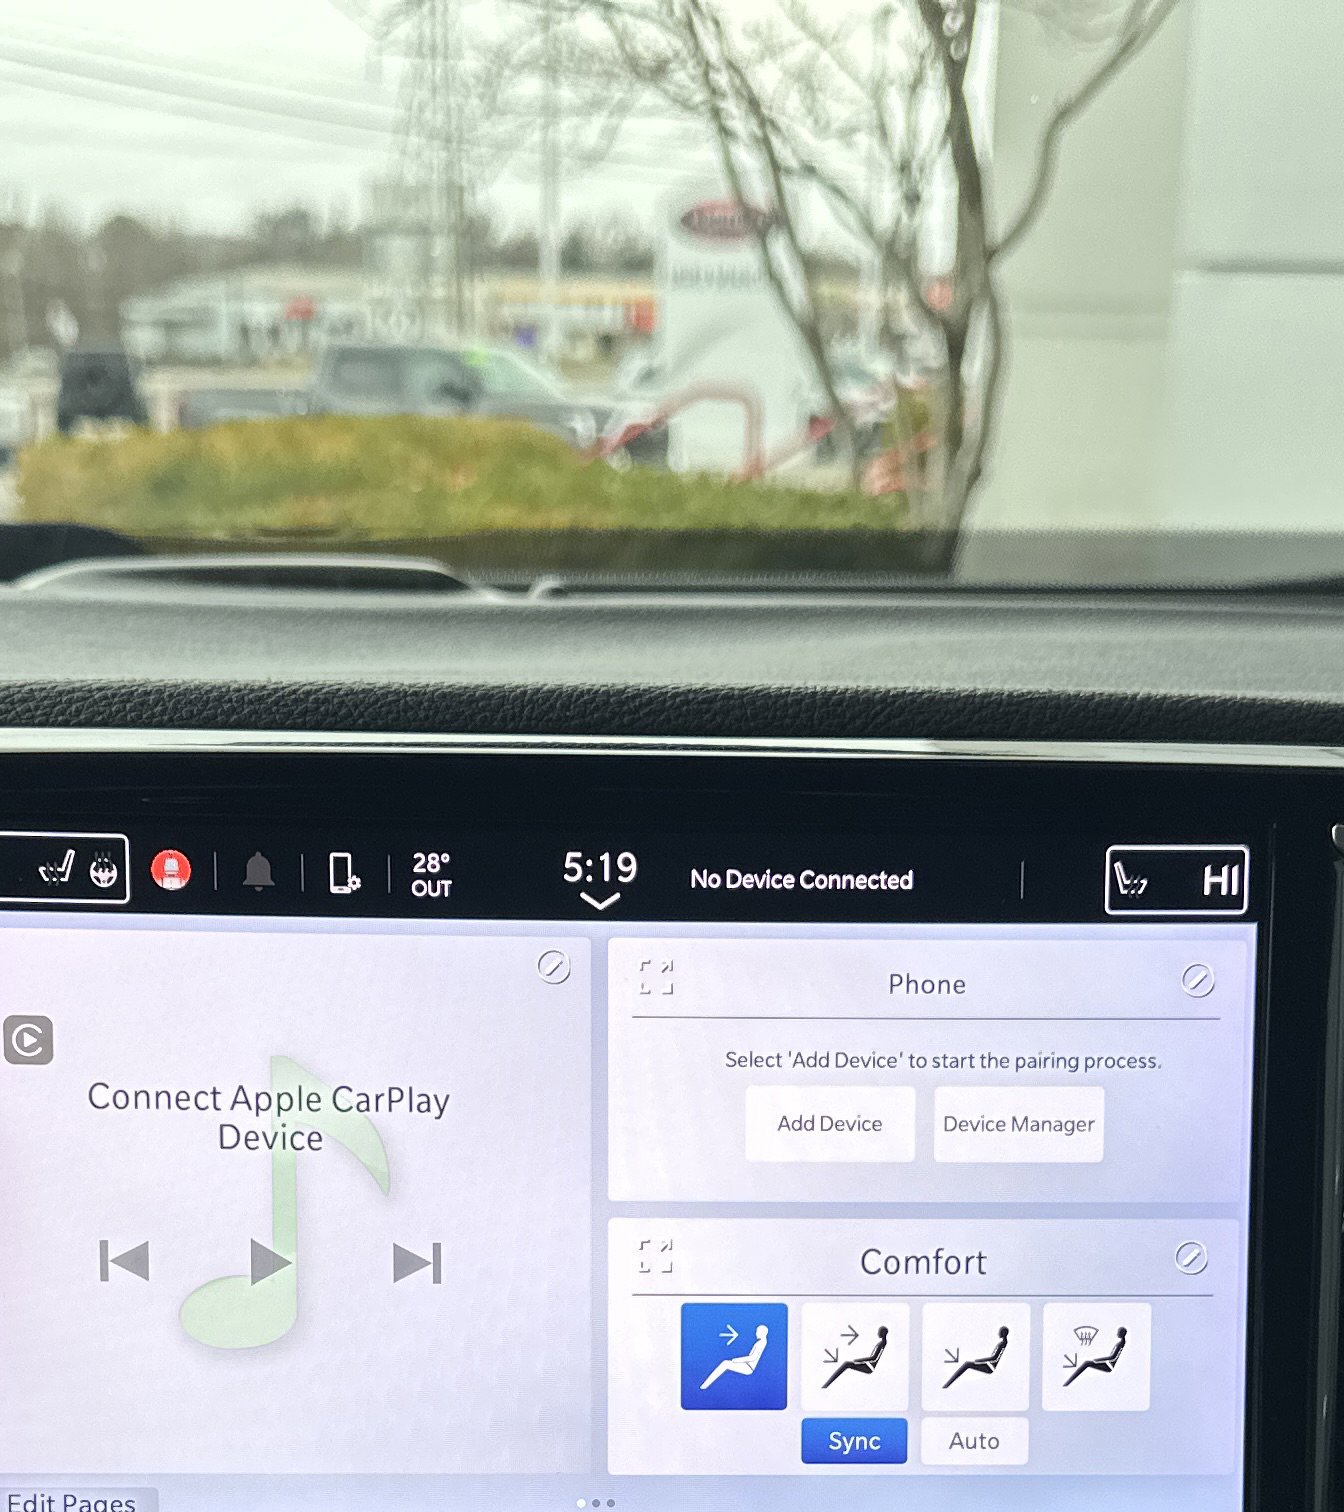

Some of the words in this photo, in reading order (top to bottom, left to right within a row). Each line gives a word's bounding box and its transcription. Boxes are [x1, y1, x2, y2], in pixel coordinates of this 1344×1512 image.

[563, 851, 637, 883] 5:19
[411, 879, 453, 898] OUT
[690, 868, 722, 889] No
[725, 868, 796, 890] Device
[799, 869, 914, 890] Connected
[1203, 864, 1240, 896] HI
[889, 972, 966, 995] Phone
[725, 1050, 783, 1068] Select
[788, 1050, 830, 1069] 'Add
[835, 1051, 903, 1069] Device'
[909, 1054, 928, 1069] to
[932, 1053, 976, 1069] start
[980, 1051, 1010, 1069] the
[1015, 1051, 1079, 1073] pairing
[1084, 1056, 1162, 1073] process.
[88, 1082, 222, 1112] Connect
[230, 1084, 322, 1118] Apple
[332, 1085, 450, 1120] CarPlay
[777, 1114, 815, 1132] Add
[820, 1114, 883, 1132] Device
[944, 1115, 1006, 1133] Device
[1011, 1115, 1096, 1137] Manager
[219, 1123, 323, 1152] Device
[861, 1247, 987, 1275] Comfort
[829, 1431, 881, 1455] Sync
[948, 1431, 1000, 1450] Auto
